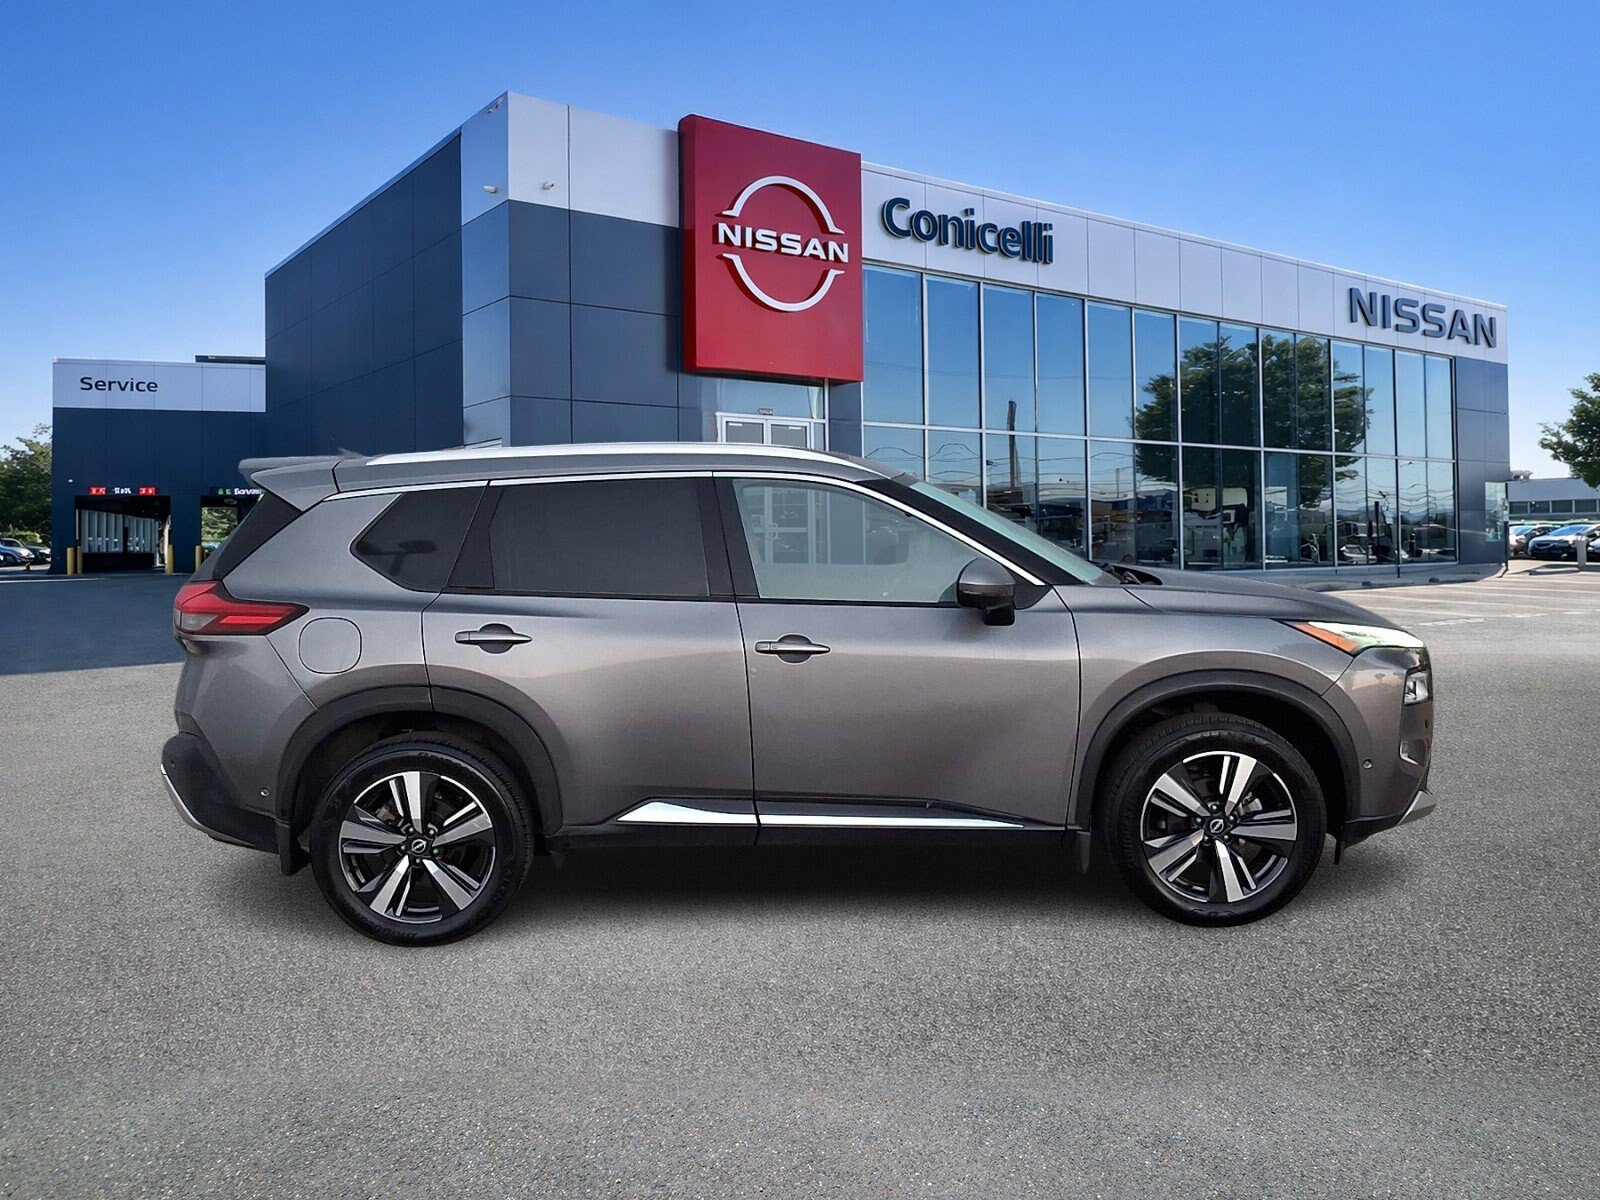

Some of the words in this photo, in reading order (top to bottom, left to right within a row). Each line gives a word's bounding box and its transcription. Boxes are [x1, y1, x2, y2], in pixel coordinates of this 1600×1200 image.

[718, 223, 849, 263] NISSAN
[882, 198, 1053, 264] Conicelli
[1349, 287, 1497, 348] NISSAN
[80, 376, 158, 392] Service
